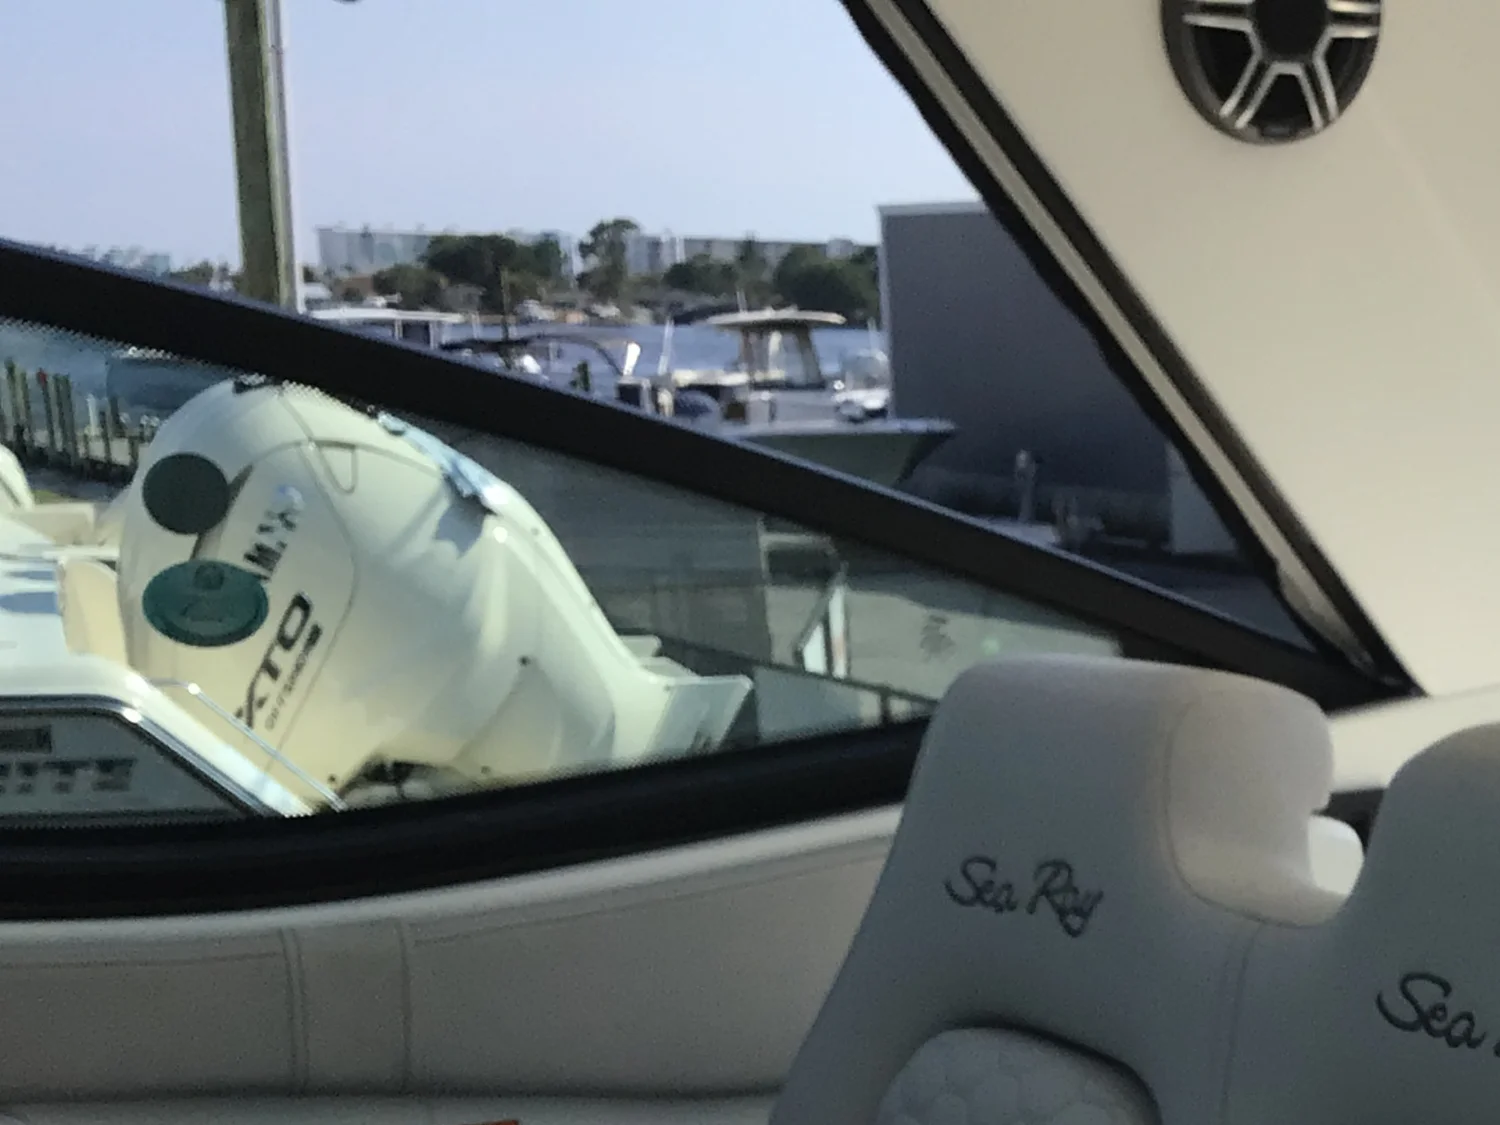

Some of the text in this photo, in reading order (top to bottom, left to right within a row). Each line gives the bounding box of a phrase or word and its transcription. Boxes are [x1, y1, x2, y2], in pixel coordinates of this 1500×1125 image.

[944, 855, 1104, 938] Sea Ray
[1376, 971, 1487, 1049] Sea
